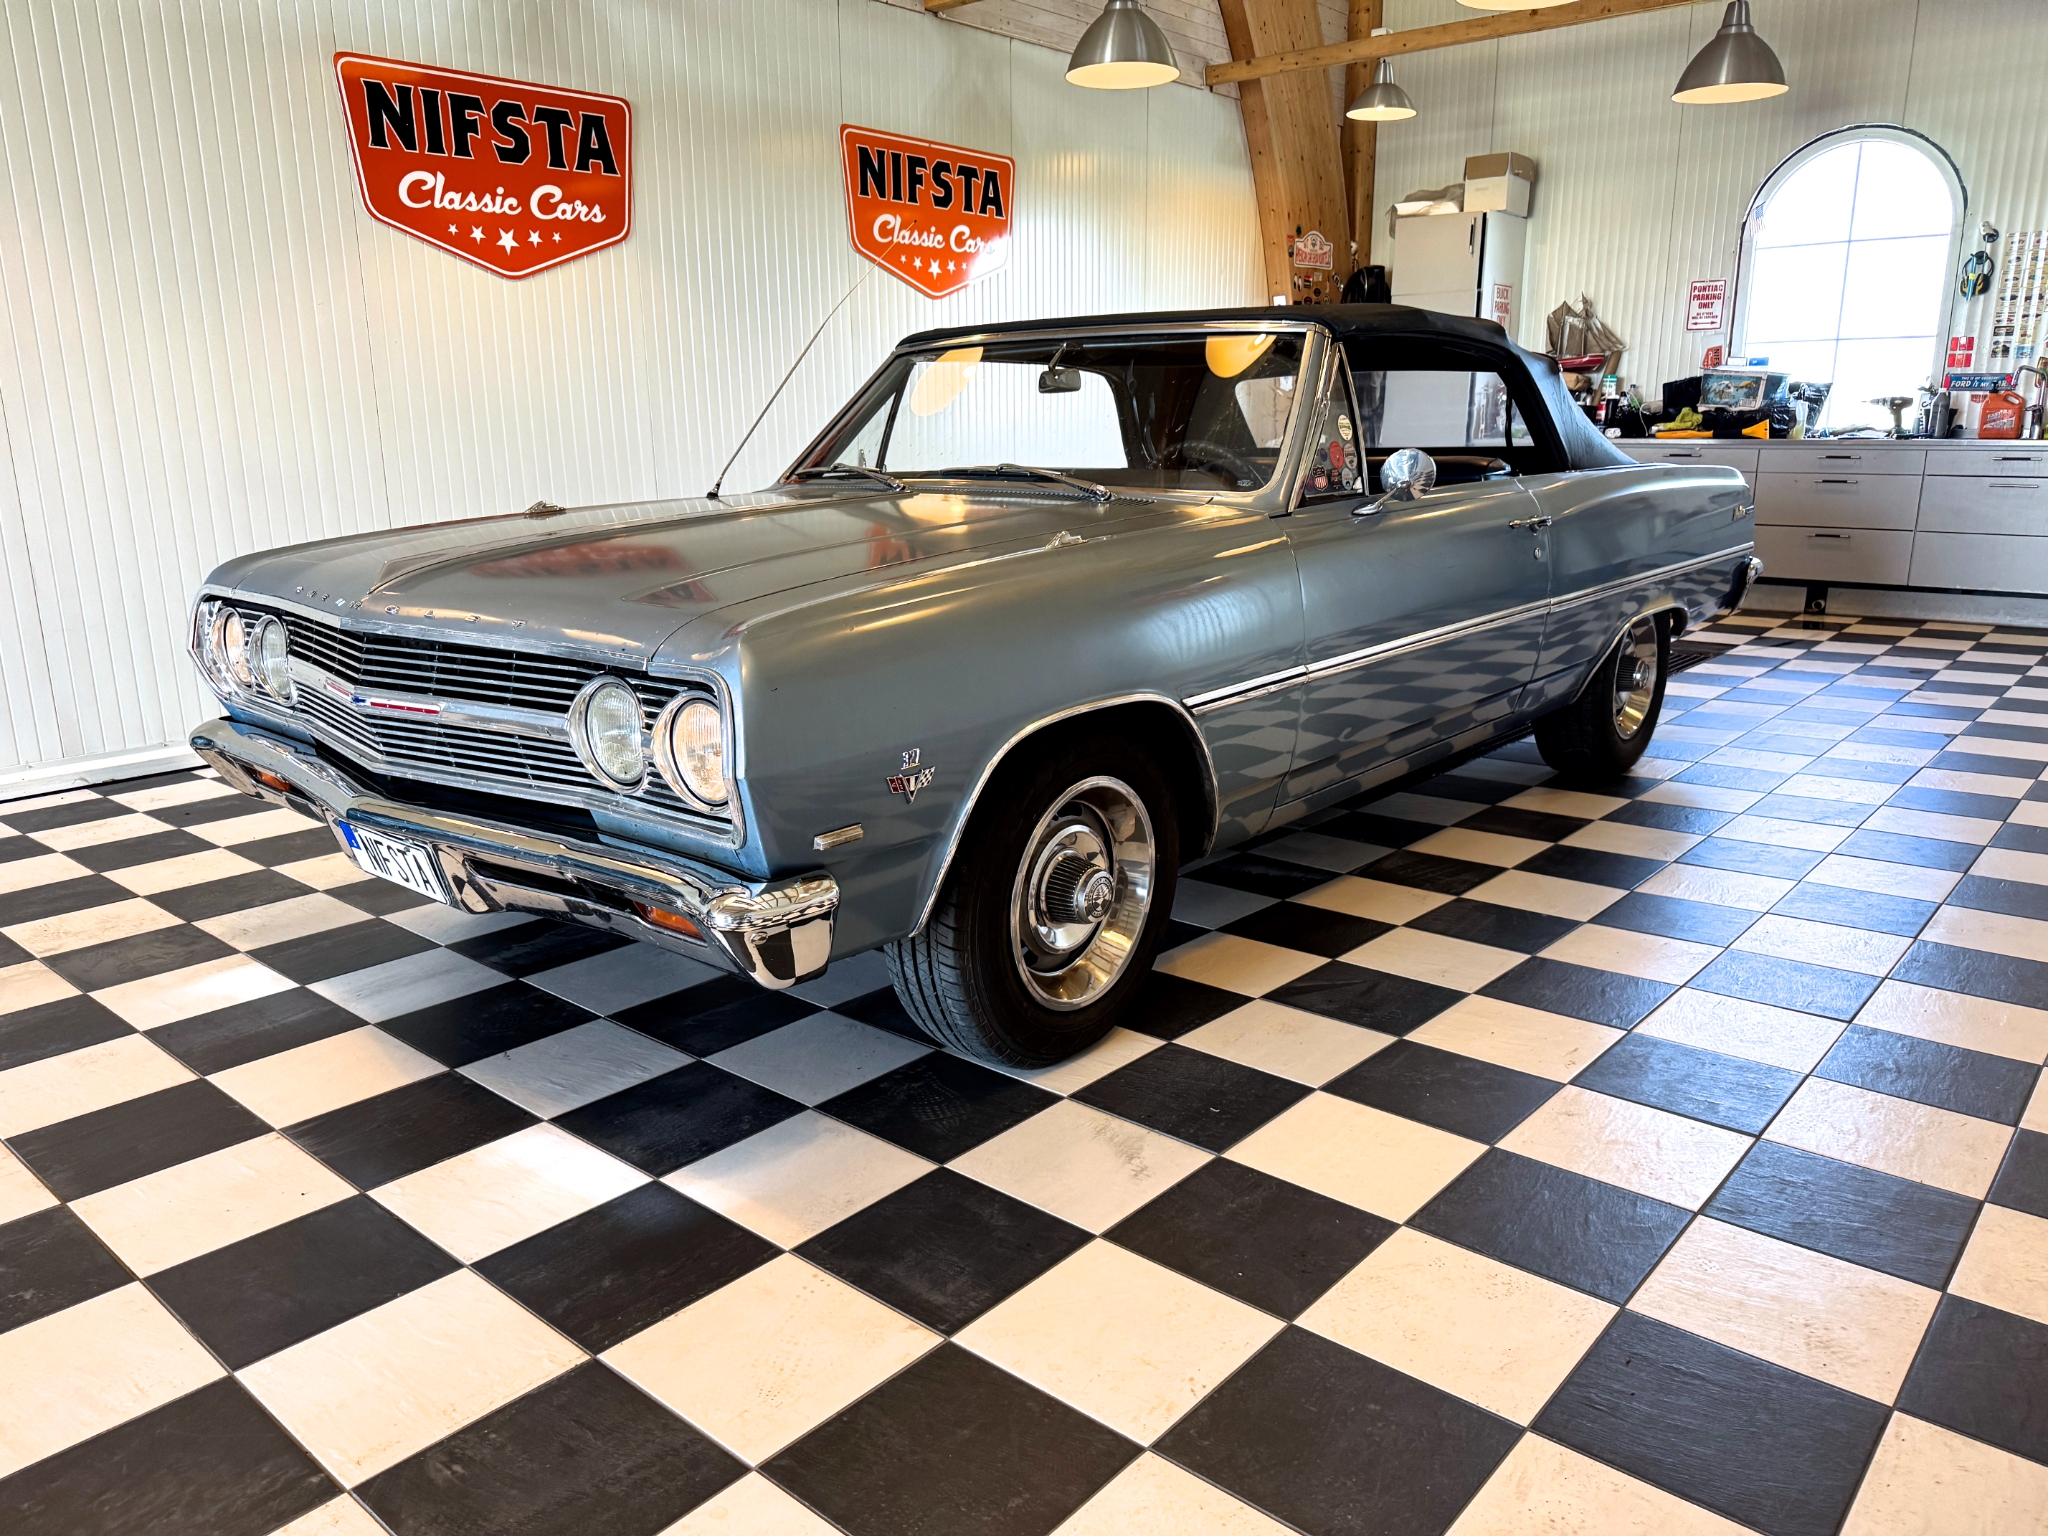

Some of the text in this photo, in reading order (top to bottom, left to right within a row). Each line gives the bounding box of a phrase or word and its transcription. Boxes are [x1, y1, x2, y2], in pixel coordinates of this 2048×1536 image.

[360, 77, 621, 177] NIFSTA
[398, 170, 606, 223] Classic Cars
[856, 143, 1006, 219] NIFSTA
[873, 213, 945, 249] Classic
[1692, 293, 1722, 301] PARKING
[1693, 285, 1723, 293] PONTIAC
[1698, 301, 1715, 309] ONLY
[358, 833, 437, 895] NIFSTA
